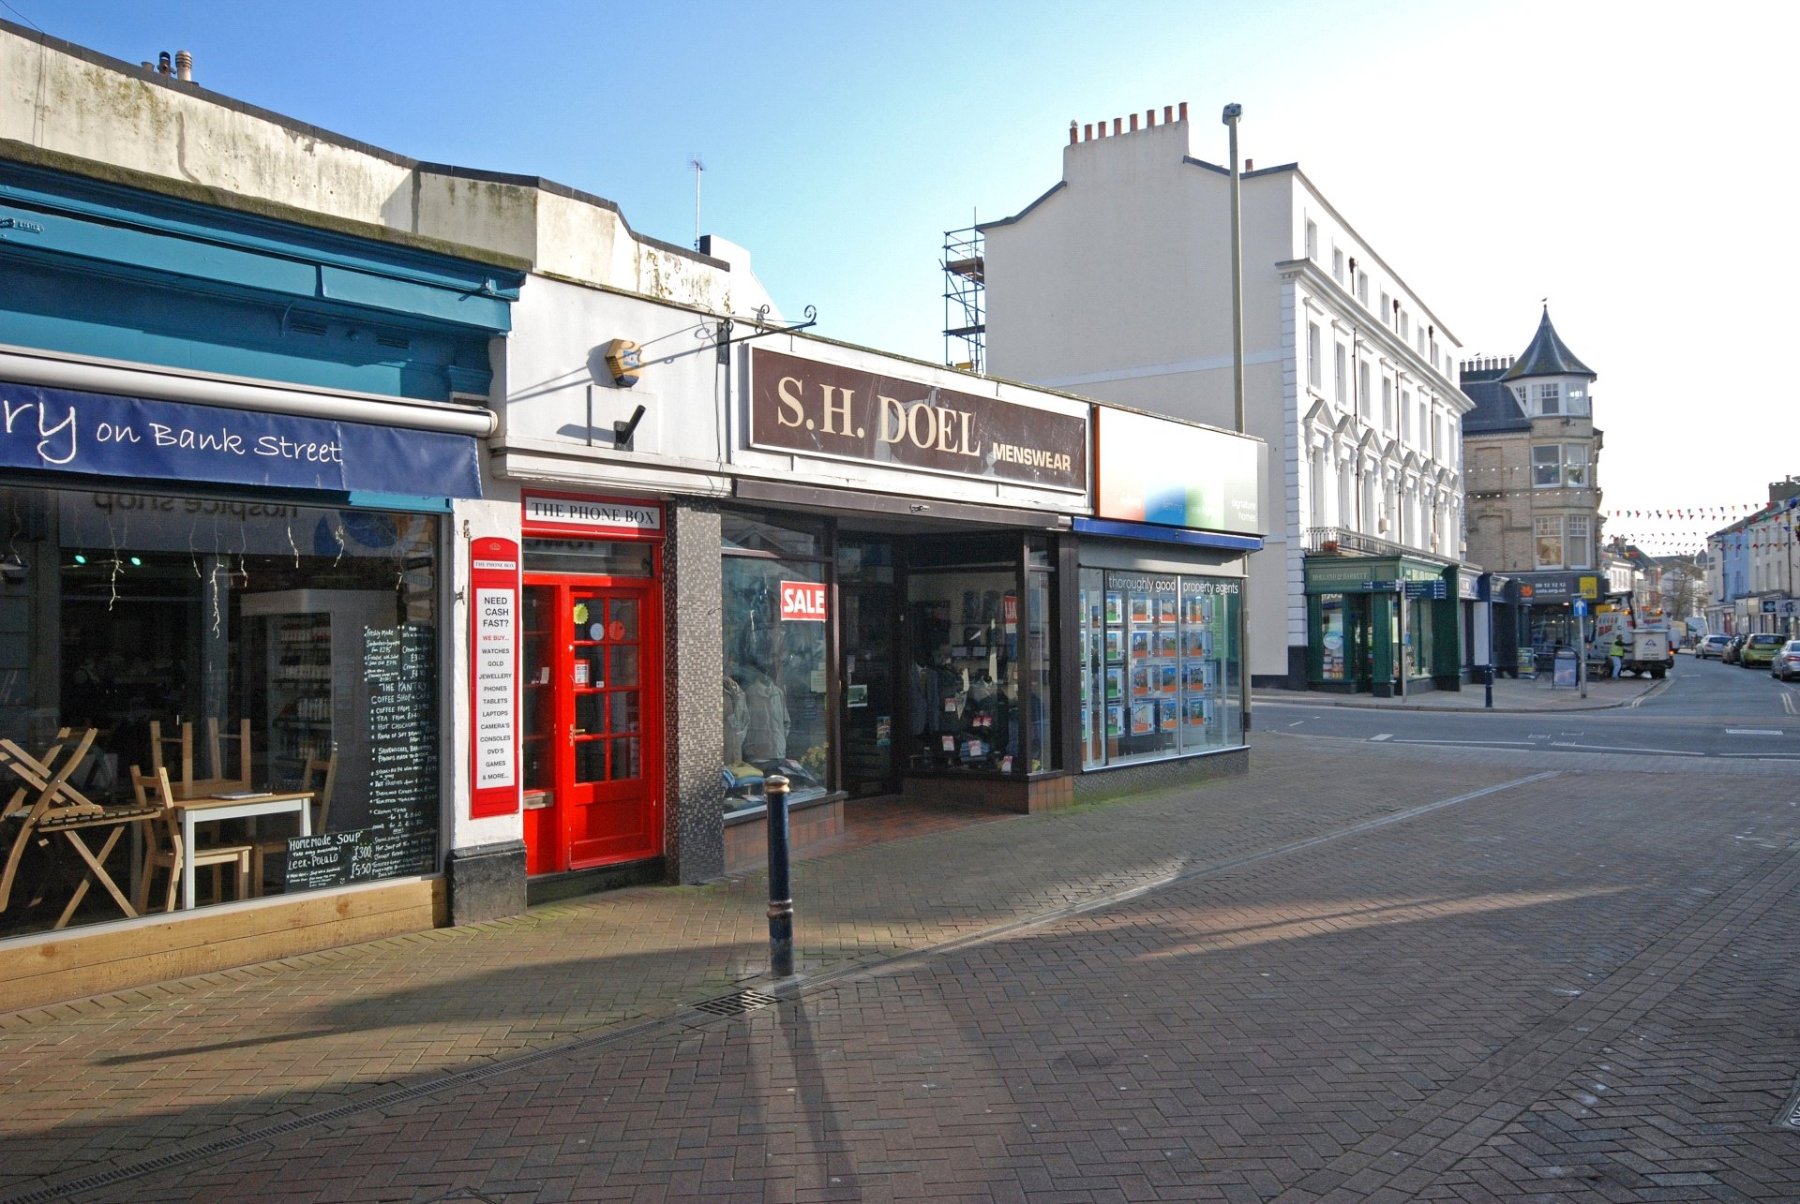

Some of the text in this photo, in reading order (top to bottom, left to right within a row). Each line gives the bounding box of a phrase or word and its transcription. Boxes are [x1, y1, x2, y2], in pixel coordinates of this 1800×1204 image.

[777, 376, 982, 458] S.H. DOEL
[96, 421, 141, 444] on
[149, 422, 245, 456] Bank
[254, 435, 343, 464] Street
[992, 441, 1071, 472] MENSWEAR
[532, 502, 655, 525] THE PHONE BOX
[1108, 576, 1238, 594] thoroughly good property agents
[484, 596, 508, 605] NEED
[783, 587, 825, 614] SALE
[485, 608, 509, 616] CASH
[483, 620, 509, 628] FAST?
[378, 682, 394, 692] THE
[371, 694, 394, 704] COFFEE
[376, 706, 396, 714] COFFEE
